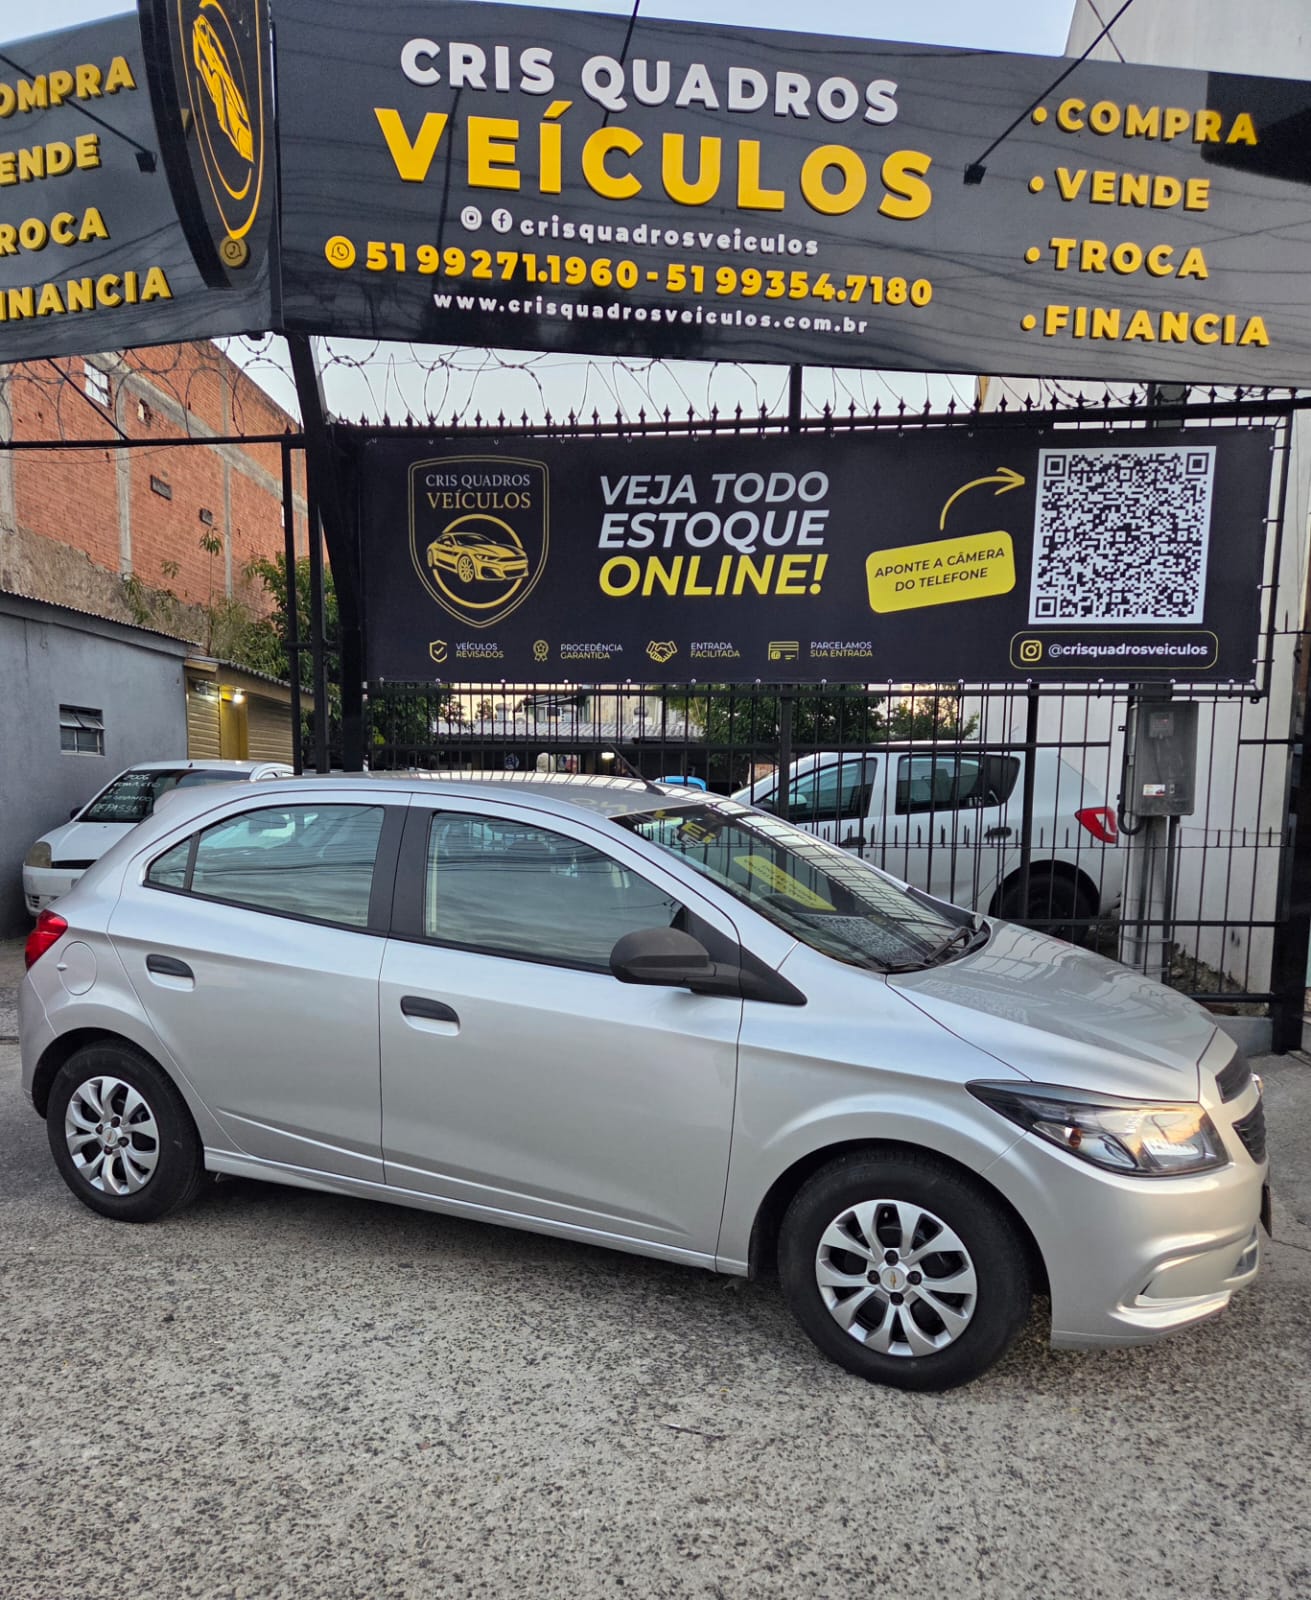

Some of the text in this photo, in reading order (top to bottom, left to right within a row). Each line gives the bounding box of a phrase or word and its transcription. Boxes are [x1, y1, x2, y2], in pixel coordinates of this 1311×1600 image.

[401, 38, 898, 123] CRIS QUADROS
[1057, 98, 1258, 146] COMPRA
[374, 101, 933, 219] VEÍCULOS
[1056, 167, 1210, 210] VENDE
[520, 214, 818, 255] crisquadrosveiculos
[1050, 237, 1209, 279] TROCA
[366, 241, 406, 272] 51
[416, 244, 639, 289] 99271.1960
[666, 263, 705, 293] 51
[715, 266, 933, 306] 99354.7180
[433, 294, 868, 334] www.crisquadrosveiculos.com.br
[1044, 304, 1270, 347] FINANCIA
[425, 474, 531, 489] CRIS QUADROS
[600, 471, 829, 505] VEJA TODO
[427, 489, 532, 510] VEÍCULOS
[598, 509, 830, 554] ESTOQUE
[599, 554, 828, 597] ONLINE!
[875, 548, 1005, 578] APONTE A CÂMERA
[895, 567, 988, 592] DO TELEFONE
[456, 641, 498, 651] VEÍCULOS
[456, 650, 505, 659] REVISADOS
[560, 642, 623, 652] PROCEDÊNCIA
[560, 651, 611, 660] GARANTIDA
[690, 642, 733, 651] ENTRADA
[690, 649, 741, 658] FACILITADA
[810, 641, 873, 650] PARCELAMOS
[810, 648, 873, 658] SUA ENTRADA
[1048, 642, 1208, 658] @crisquadrosveiculos
